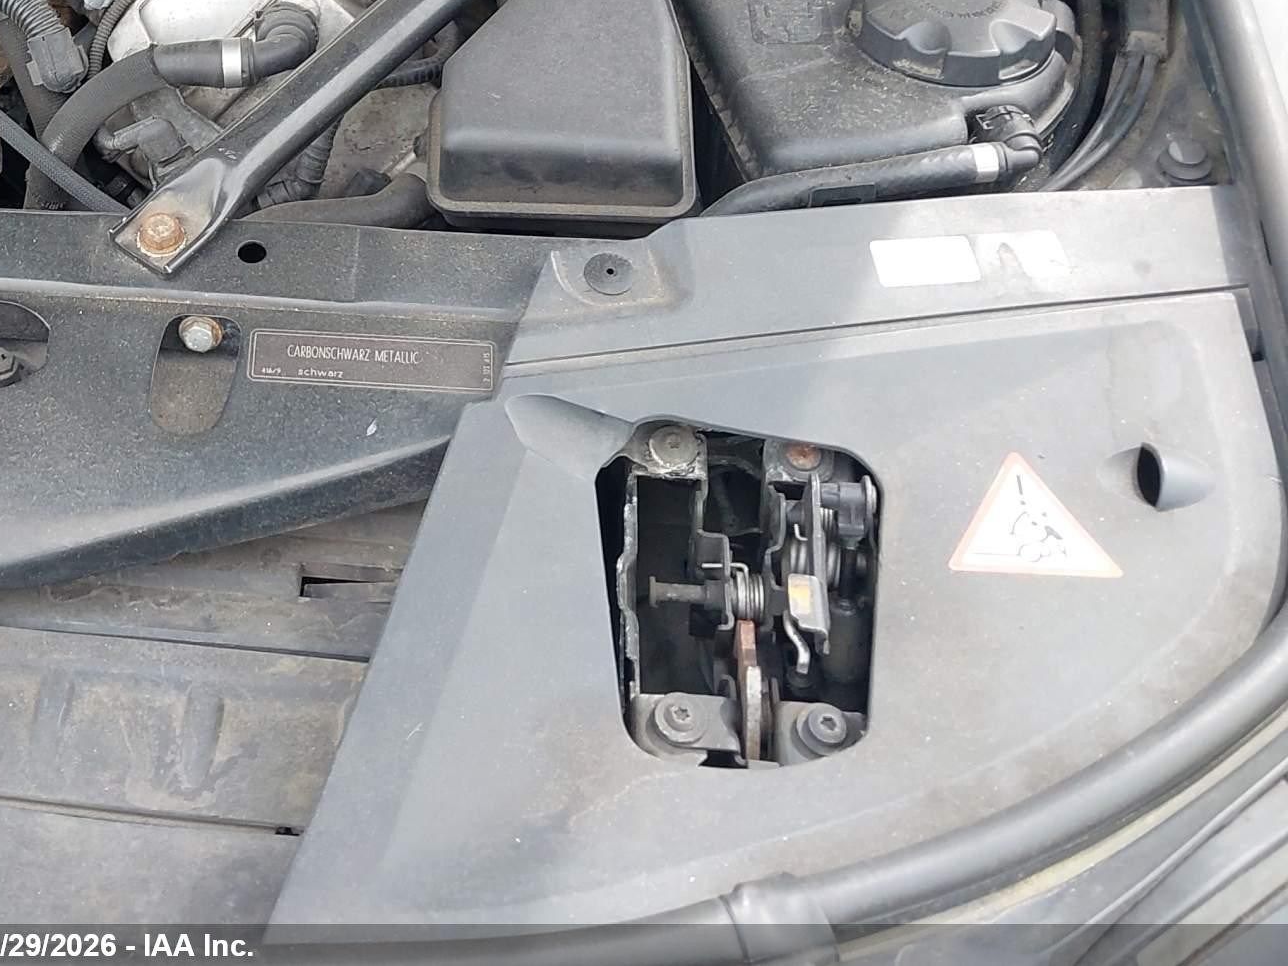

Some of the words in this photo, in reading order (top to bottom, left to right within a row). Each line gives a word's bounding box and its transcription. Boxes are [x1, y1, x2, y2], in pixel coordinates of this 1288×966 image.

[287, 344, 370, 362] CARBONSCHWARZ
[374, 350, 420, 364] METALLIC
[298, 367, 344, 379] schwarz
